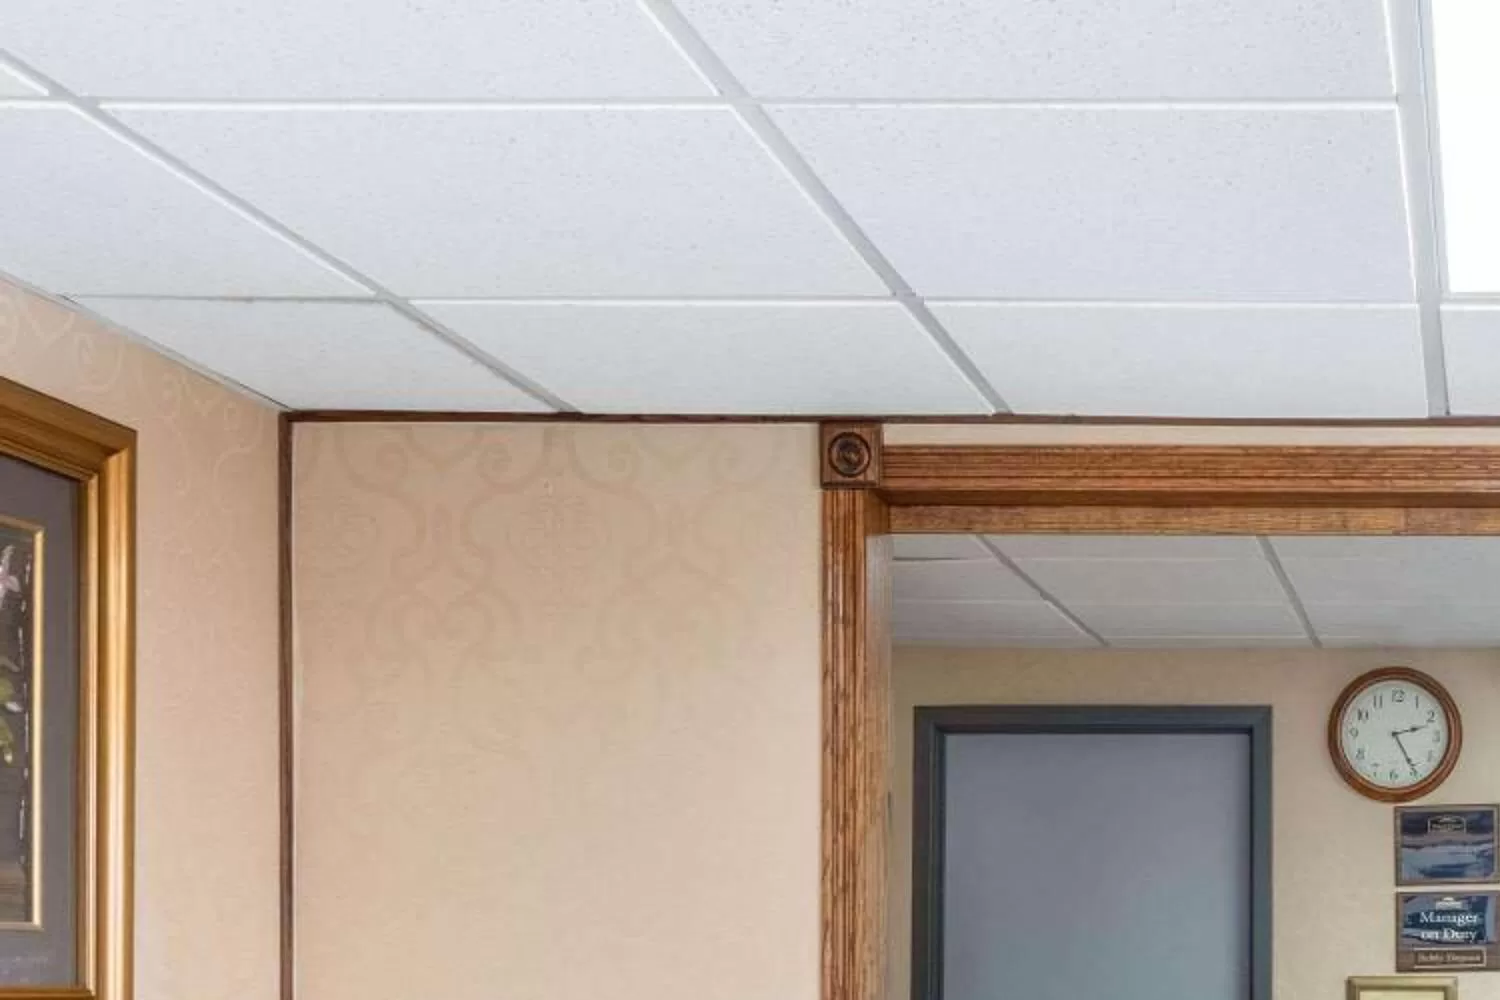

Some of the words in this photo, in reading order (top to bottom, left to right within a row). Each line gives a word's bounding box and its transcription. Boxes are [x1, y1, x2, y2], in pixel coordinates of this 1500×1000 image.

[1427, 710, 1436, 723] 2
[1419, 911, 1478, 927] Manager
[1420, 929, 1439, 941] on
[1443, 926, 1478, 943] Duty
